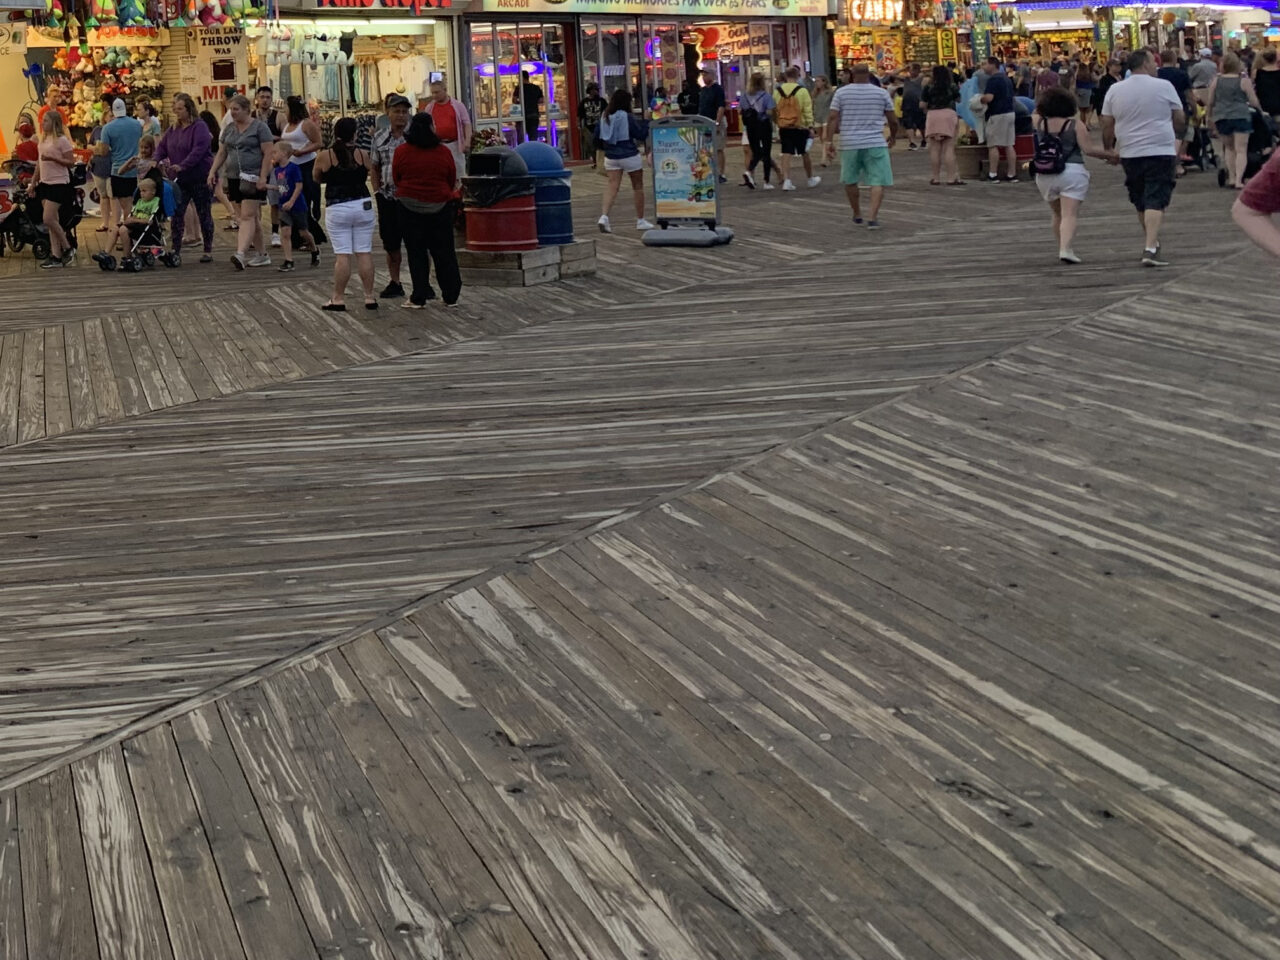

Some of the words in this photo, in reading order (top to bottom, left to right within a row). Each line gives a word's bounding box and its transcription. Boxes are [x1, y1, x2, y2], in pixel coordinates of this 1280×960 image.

[199, 27, 221, 35] YOUR
[223, 26, 242, 34] LAST
[200, 36, 241, 46] THROW
